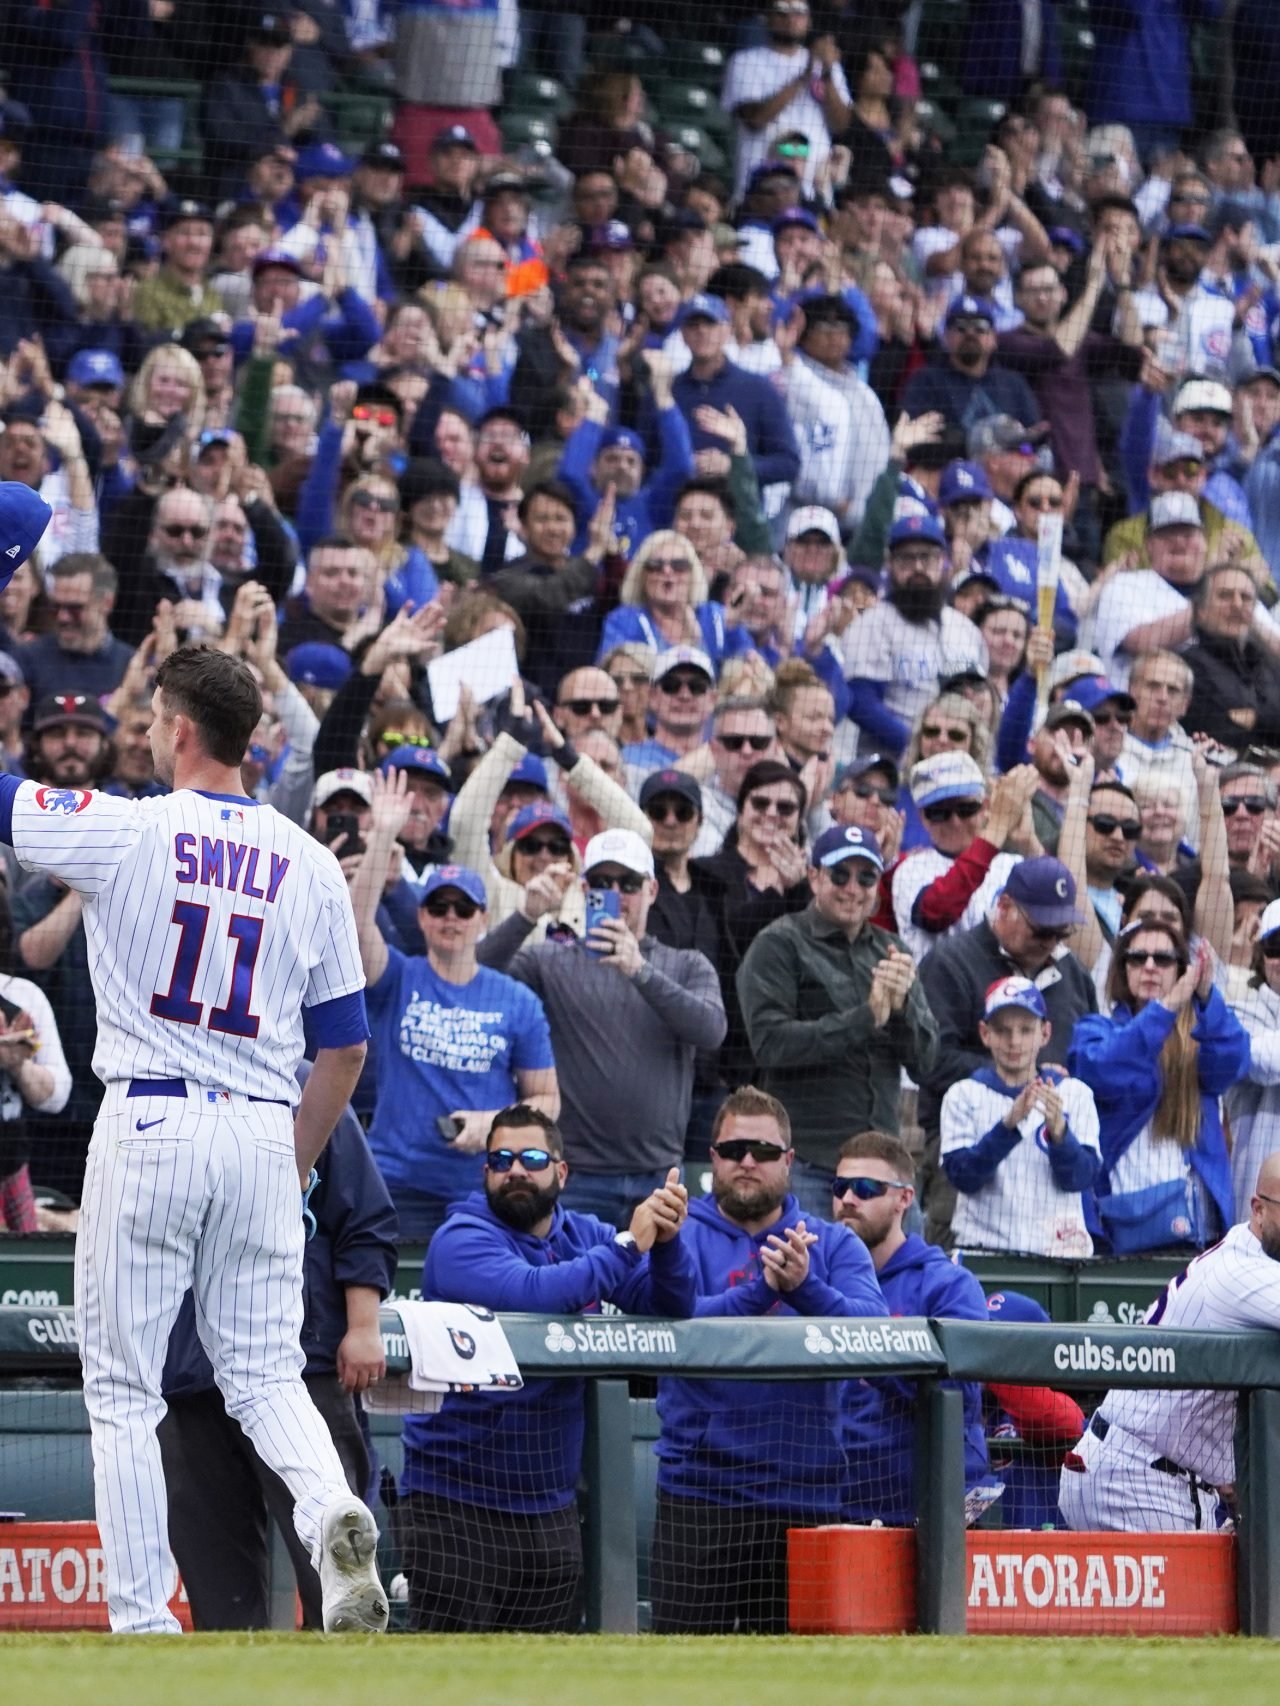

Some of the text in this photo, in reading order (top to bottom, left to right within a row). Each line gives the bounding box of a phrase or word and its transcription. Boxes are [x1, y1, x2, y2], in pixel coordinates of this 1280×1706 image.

[175, 832, 291, 904] SMYLY
[149, 899, 265, 1039] 11
[1054, 1336, 1176, 1373] cubs.com
